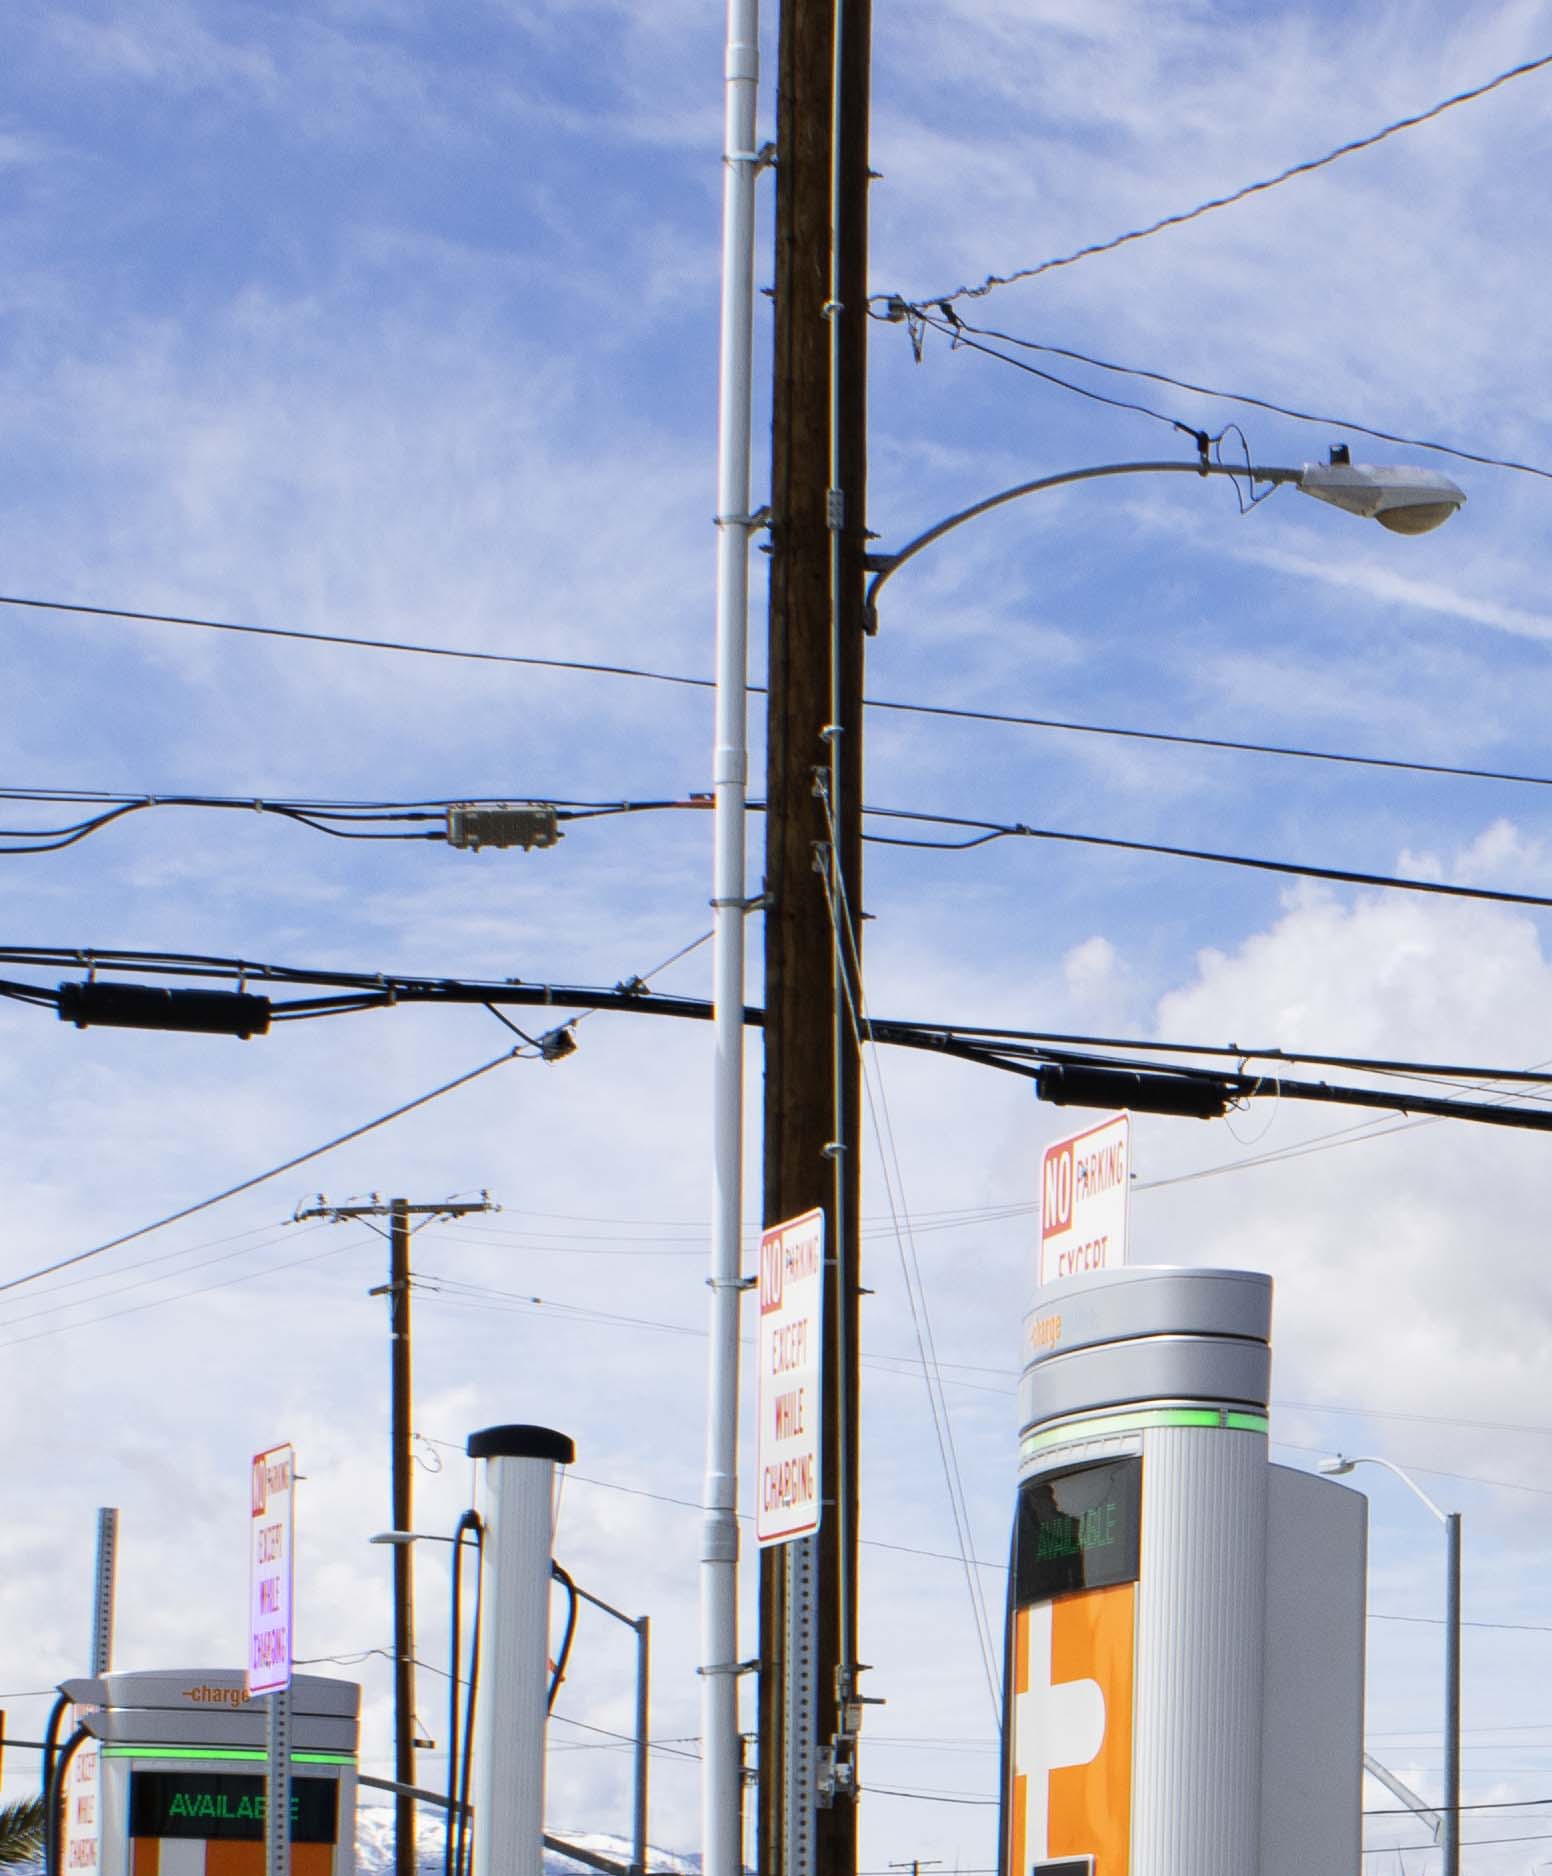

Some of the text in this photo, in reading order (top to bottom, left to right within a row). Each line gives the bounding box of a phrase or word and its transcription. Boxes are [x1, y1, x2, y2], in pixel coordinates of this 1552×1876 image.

[1045, 1141, 1124, 1229] NO PARKING
[761, 1238, 782, 1306] NO
[772, 1318, 808, 1376] EXCEPT
[775, 1387, 804, 1441] WHILE
[764, 1453, 813, 1512] CHARGING
[182, 1684, 251, 1708] charge
[168, 1792, 299, 1821] AVAILABE
